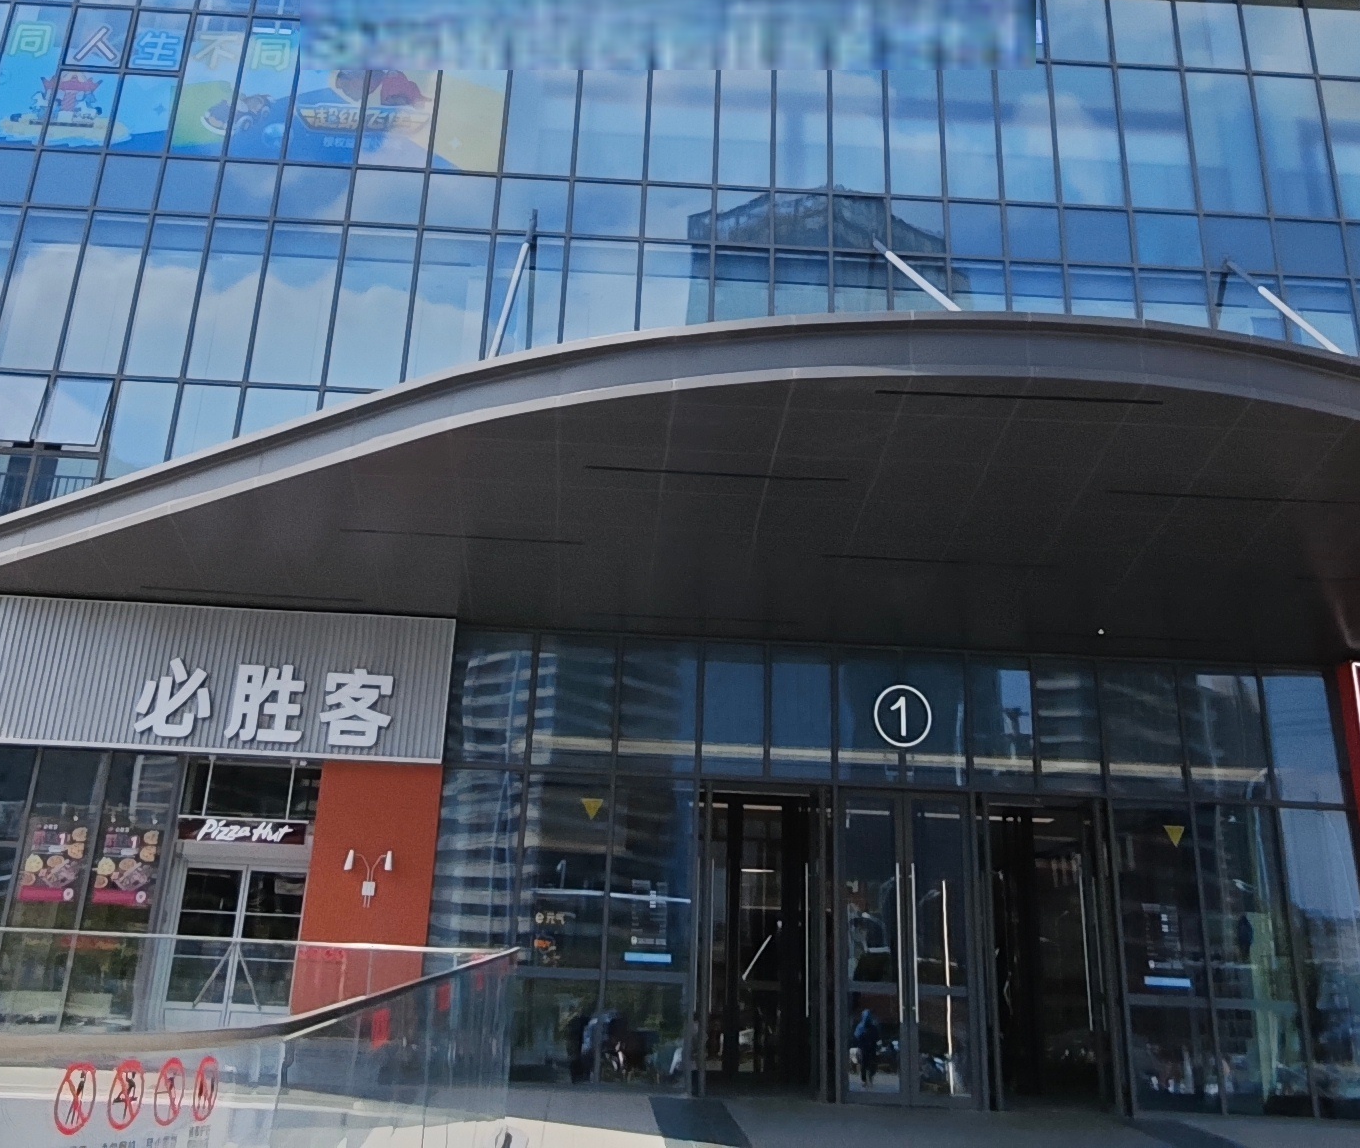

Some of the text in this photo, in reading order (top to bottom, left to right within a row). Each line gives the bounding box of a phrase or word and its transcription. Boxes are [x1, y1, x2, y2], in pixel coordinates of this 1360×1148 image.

[135, 658, 395, 747] 必胜客
[196, 818, 294, 843] Pizza Hut
